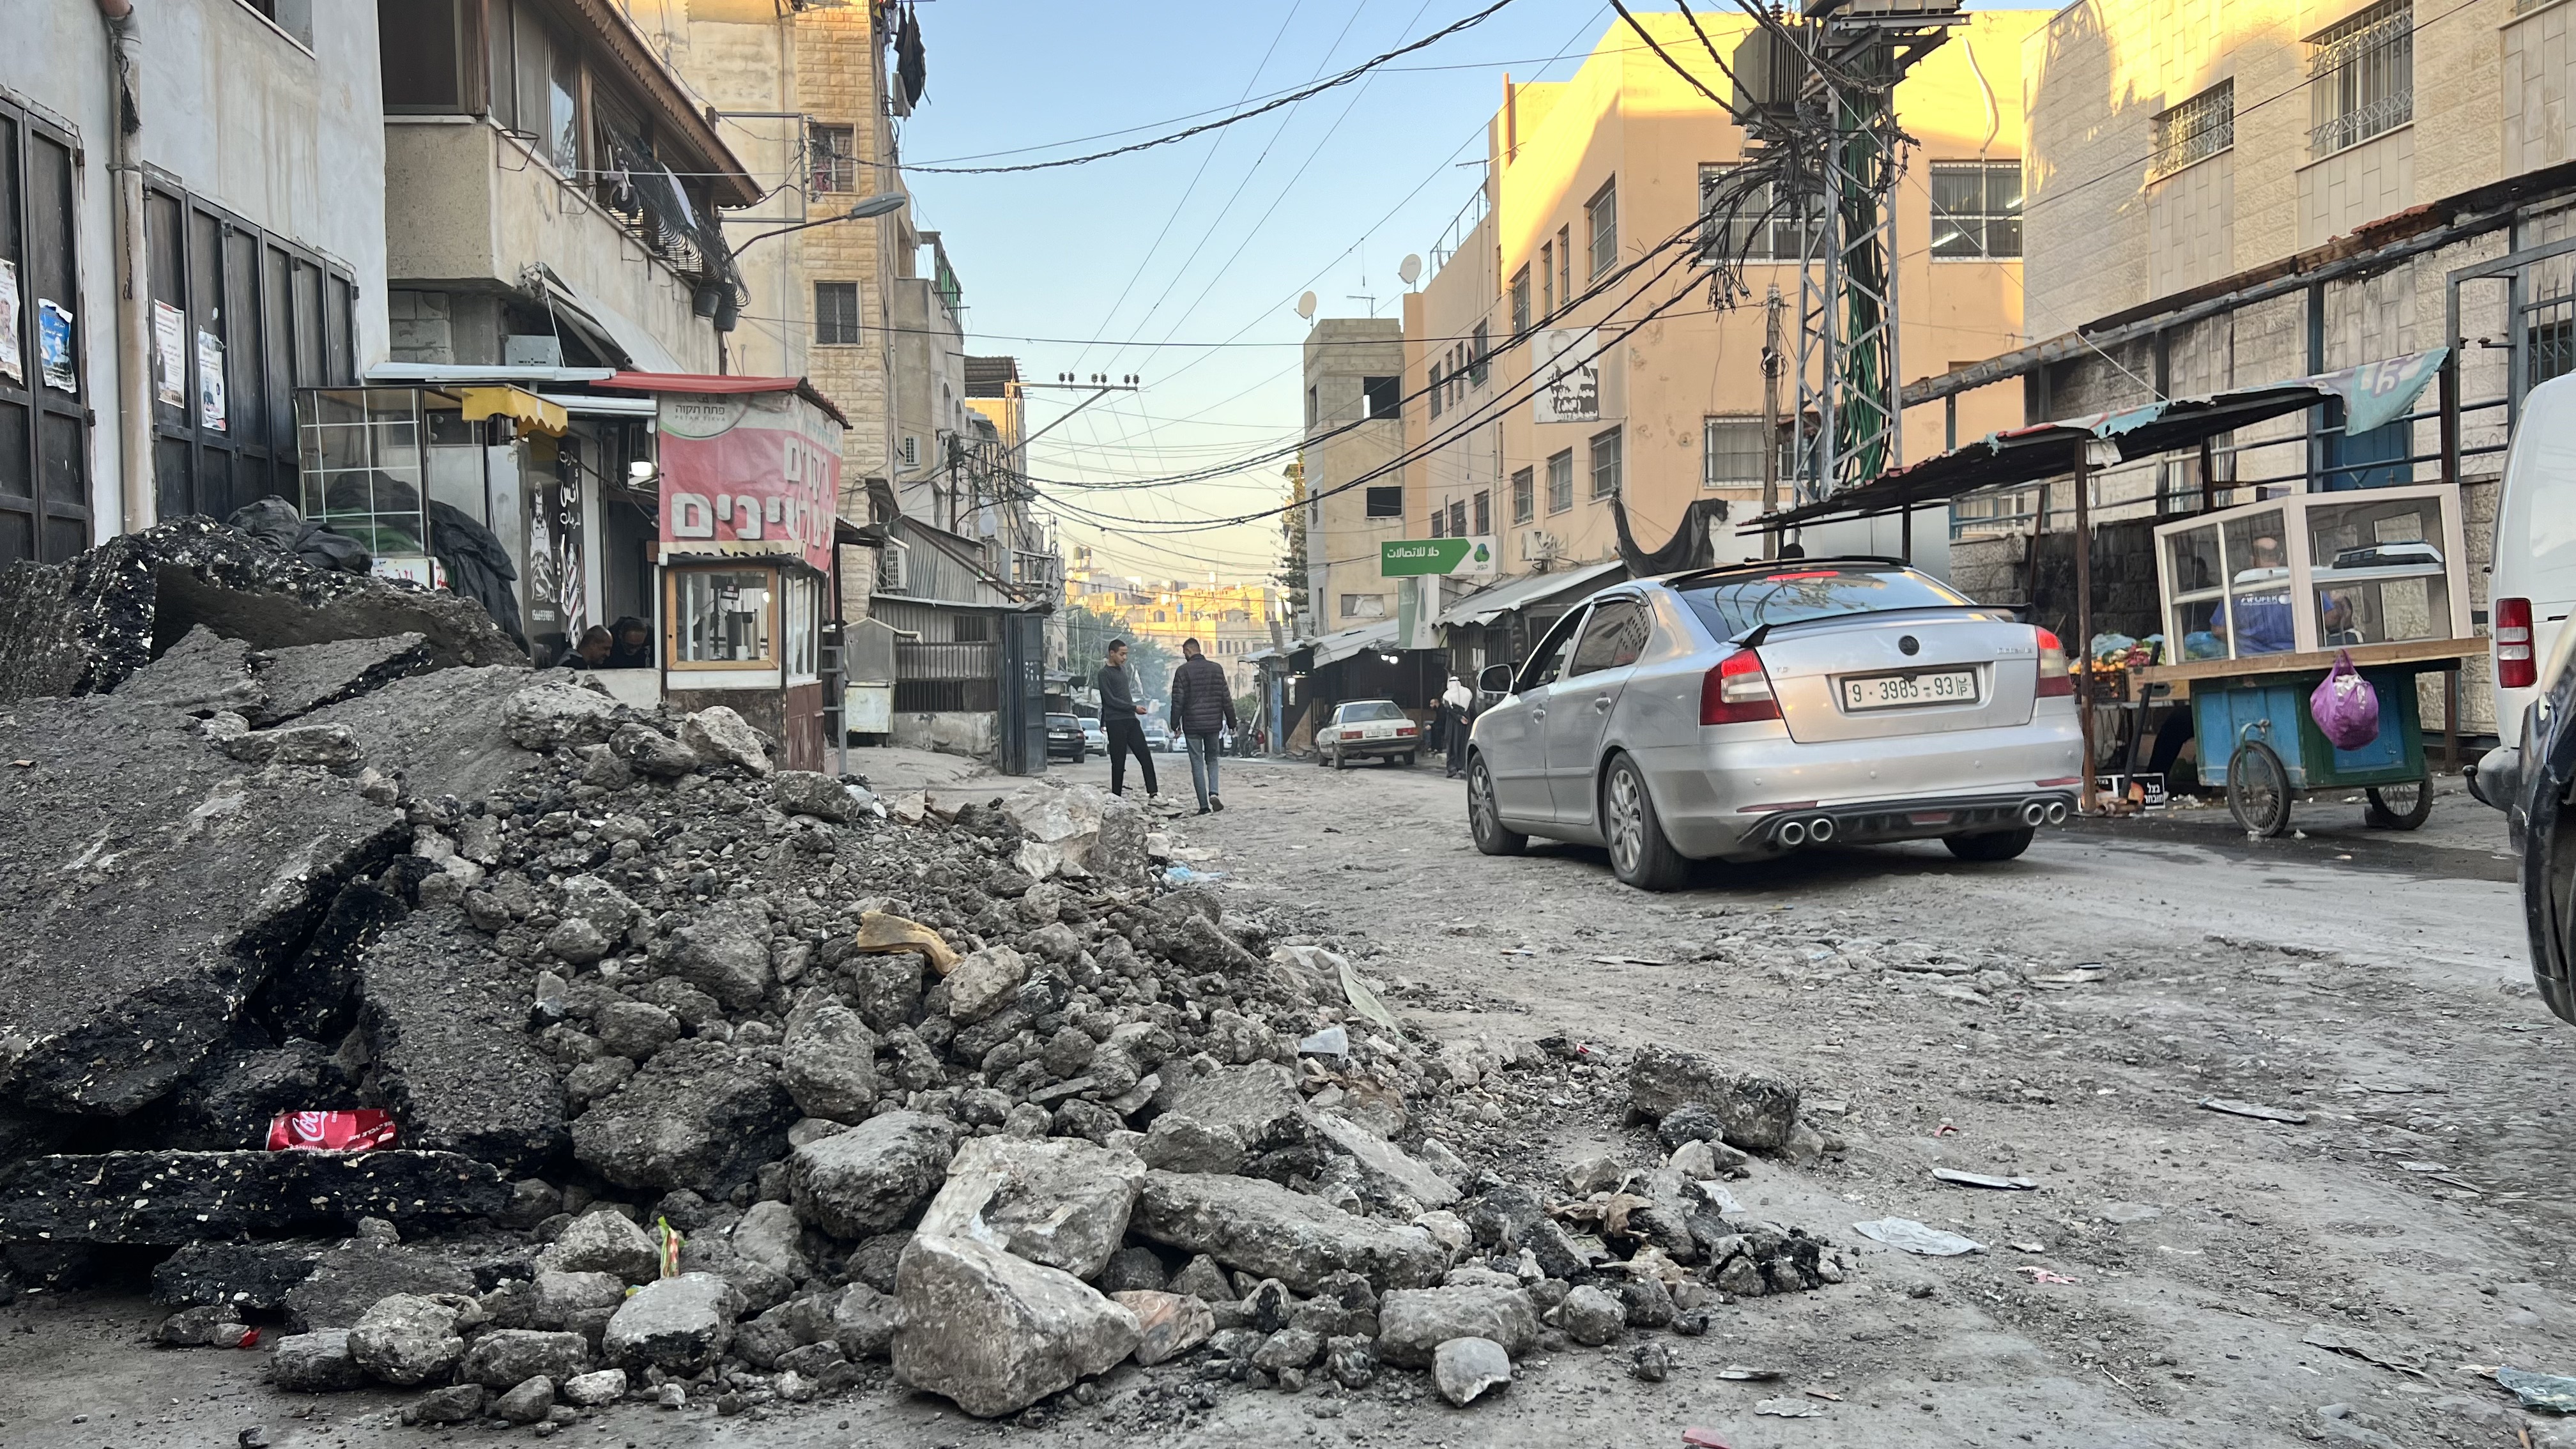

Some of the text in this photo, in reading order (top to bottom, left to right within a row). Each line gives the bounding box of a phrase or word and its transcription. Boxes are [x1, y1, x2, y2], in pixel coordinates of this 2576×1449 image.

[675, 404, 725, 415] פתח תקוה
[560, 468, 579, 508] أنس
[1386, 546, 1426, 558] للاتصالات
[2147, 781, 2161, 793] בצל
[2144, 795, 2164, 804] מובחר
